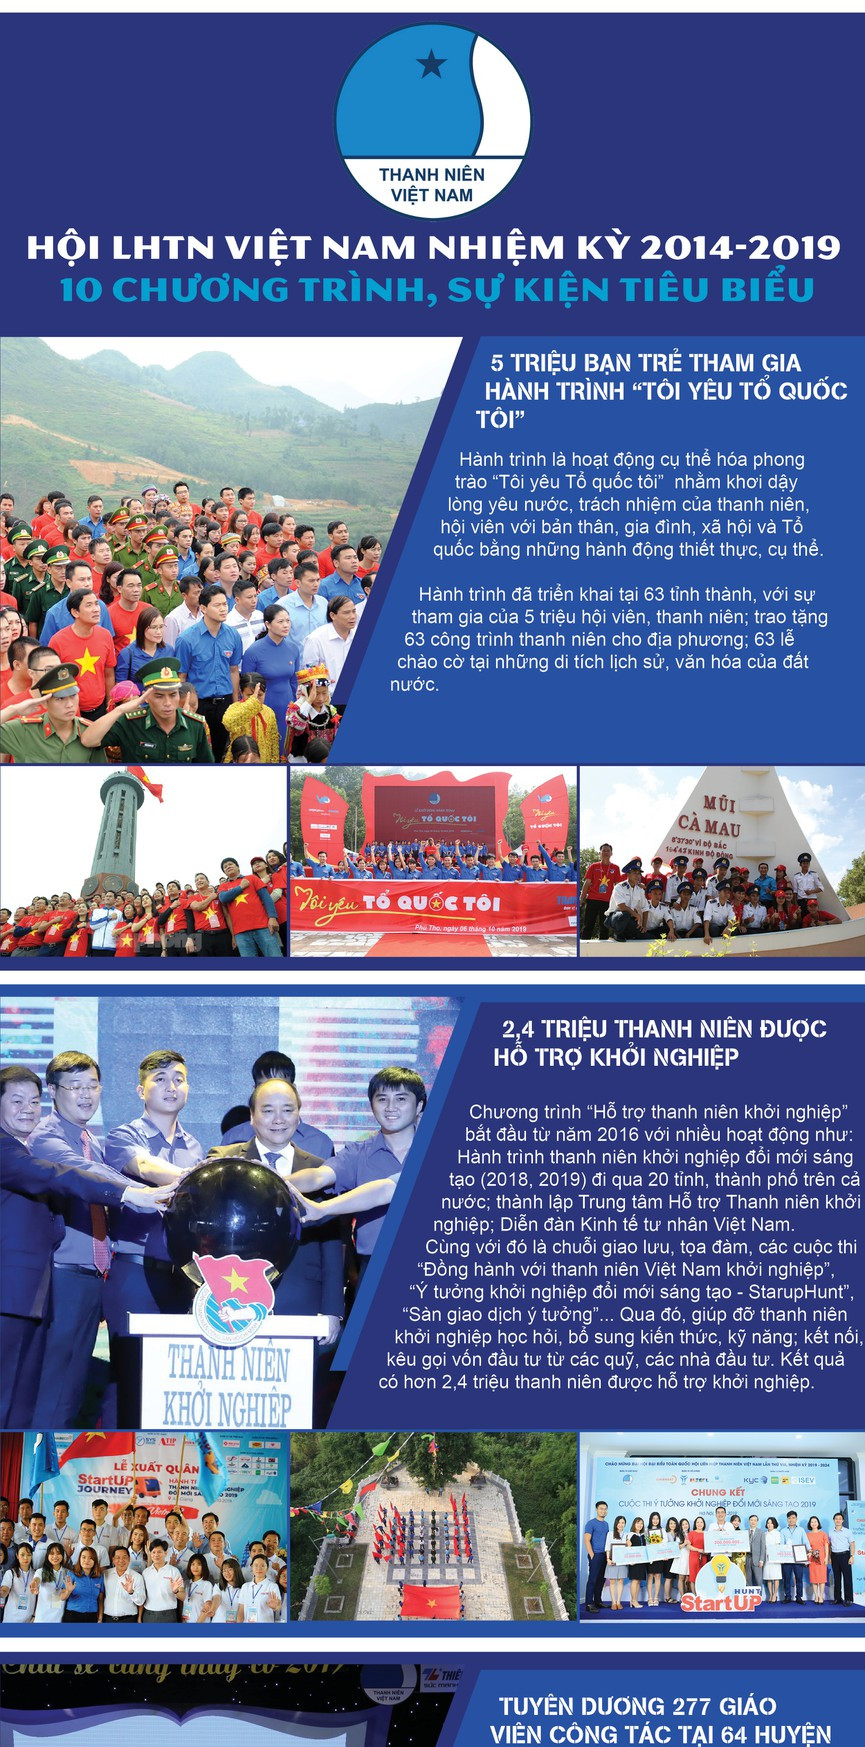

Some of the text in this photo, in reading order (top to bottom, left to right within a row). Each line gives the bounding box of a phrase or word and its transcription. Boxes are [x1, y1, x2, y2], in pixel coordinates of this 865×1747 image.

[703, 794, 735, 813] MŨI
[678, 812, 741, 838] CÀ MAU
[363, 890, 390, 910] TỔ
[398, 891, 458, 912] QUỐC
[463, 894, 500, 912] TÔI
[168, 1338, 290, 1382] THANH NIÊN
[163, 1380, 292, 1427] KHỞI NGHIỆP
[114, 1459, 129, 1471] LỄ
[78, 1485, 133, 1495] JOURNEY
[691, 1485, 745, 1497] CHUNG KẾT
[681, 1594, 762, 1612] StartUP
